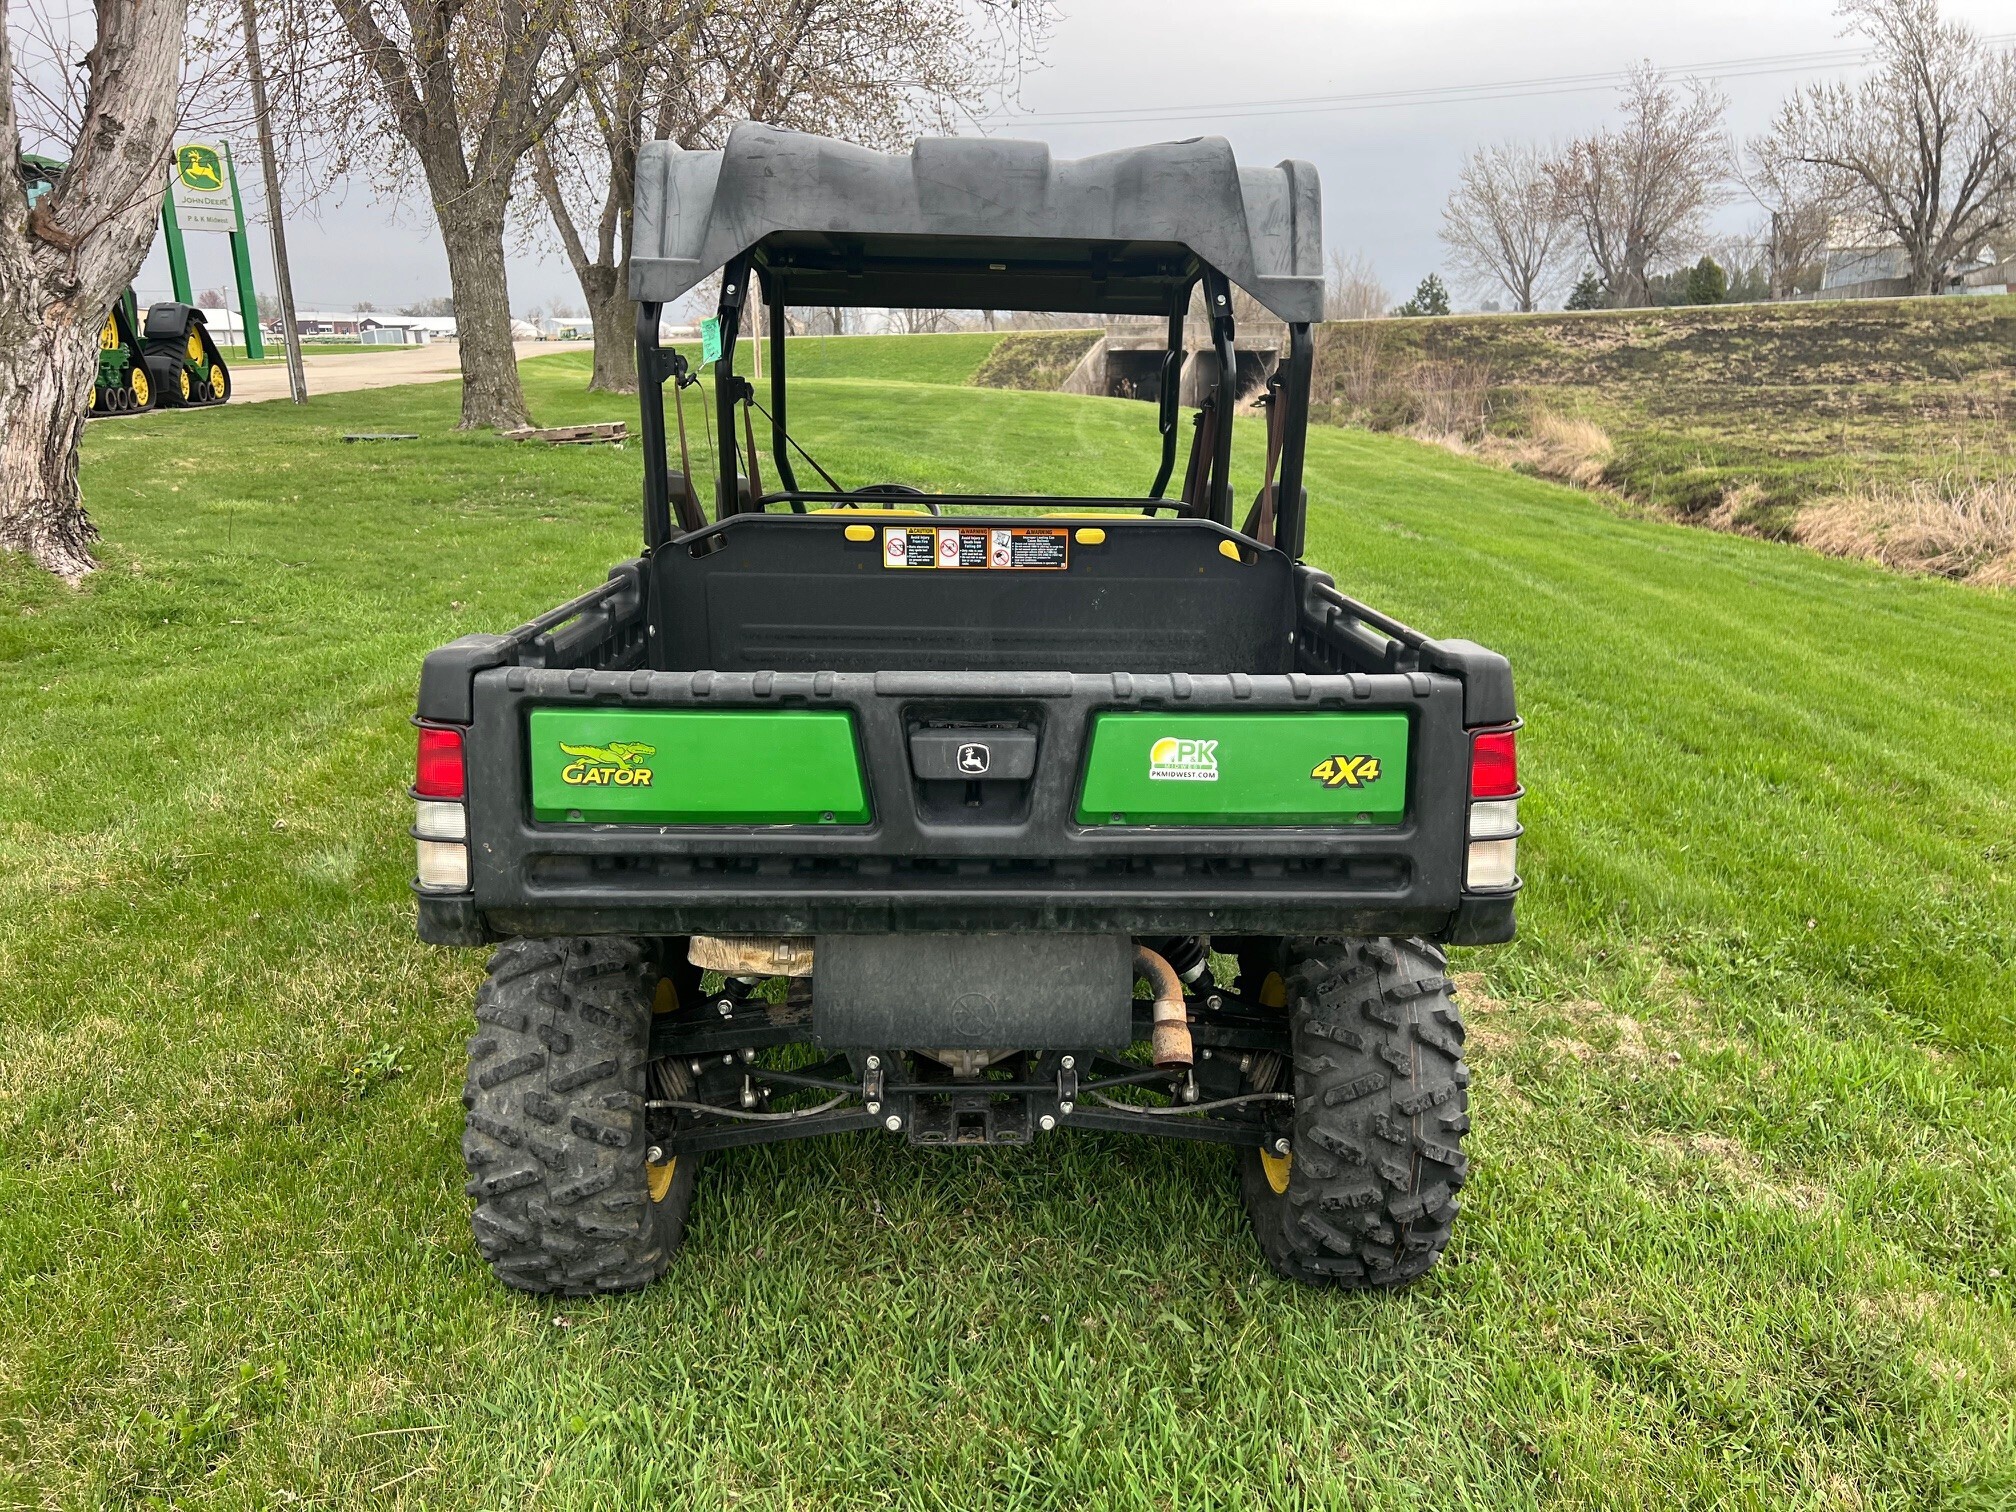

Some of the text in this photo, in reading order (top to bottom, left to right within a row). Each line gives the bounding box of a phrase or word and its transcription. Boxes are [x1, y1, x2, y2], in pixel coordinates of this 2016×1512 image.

[182, 196, 229, 206] JOHN DEERE
[206, 216, 229, 224] Midwest
[561, 764, 652, 787] GATOR
[1151, 771, 1216, 779] PKMIDWEST.COM
